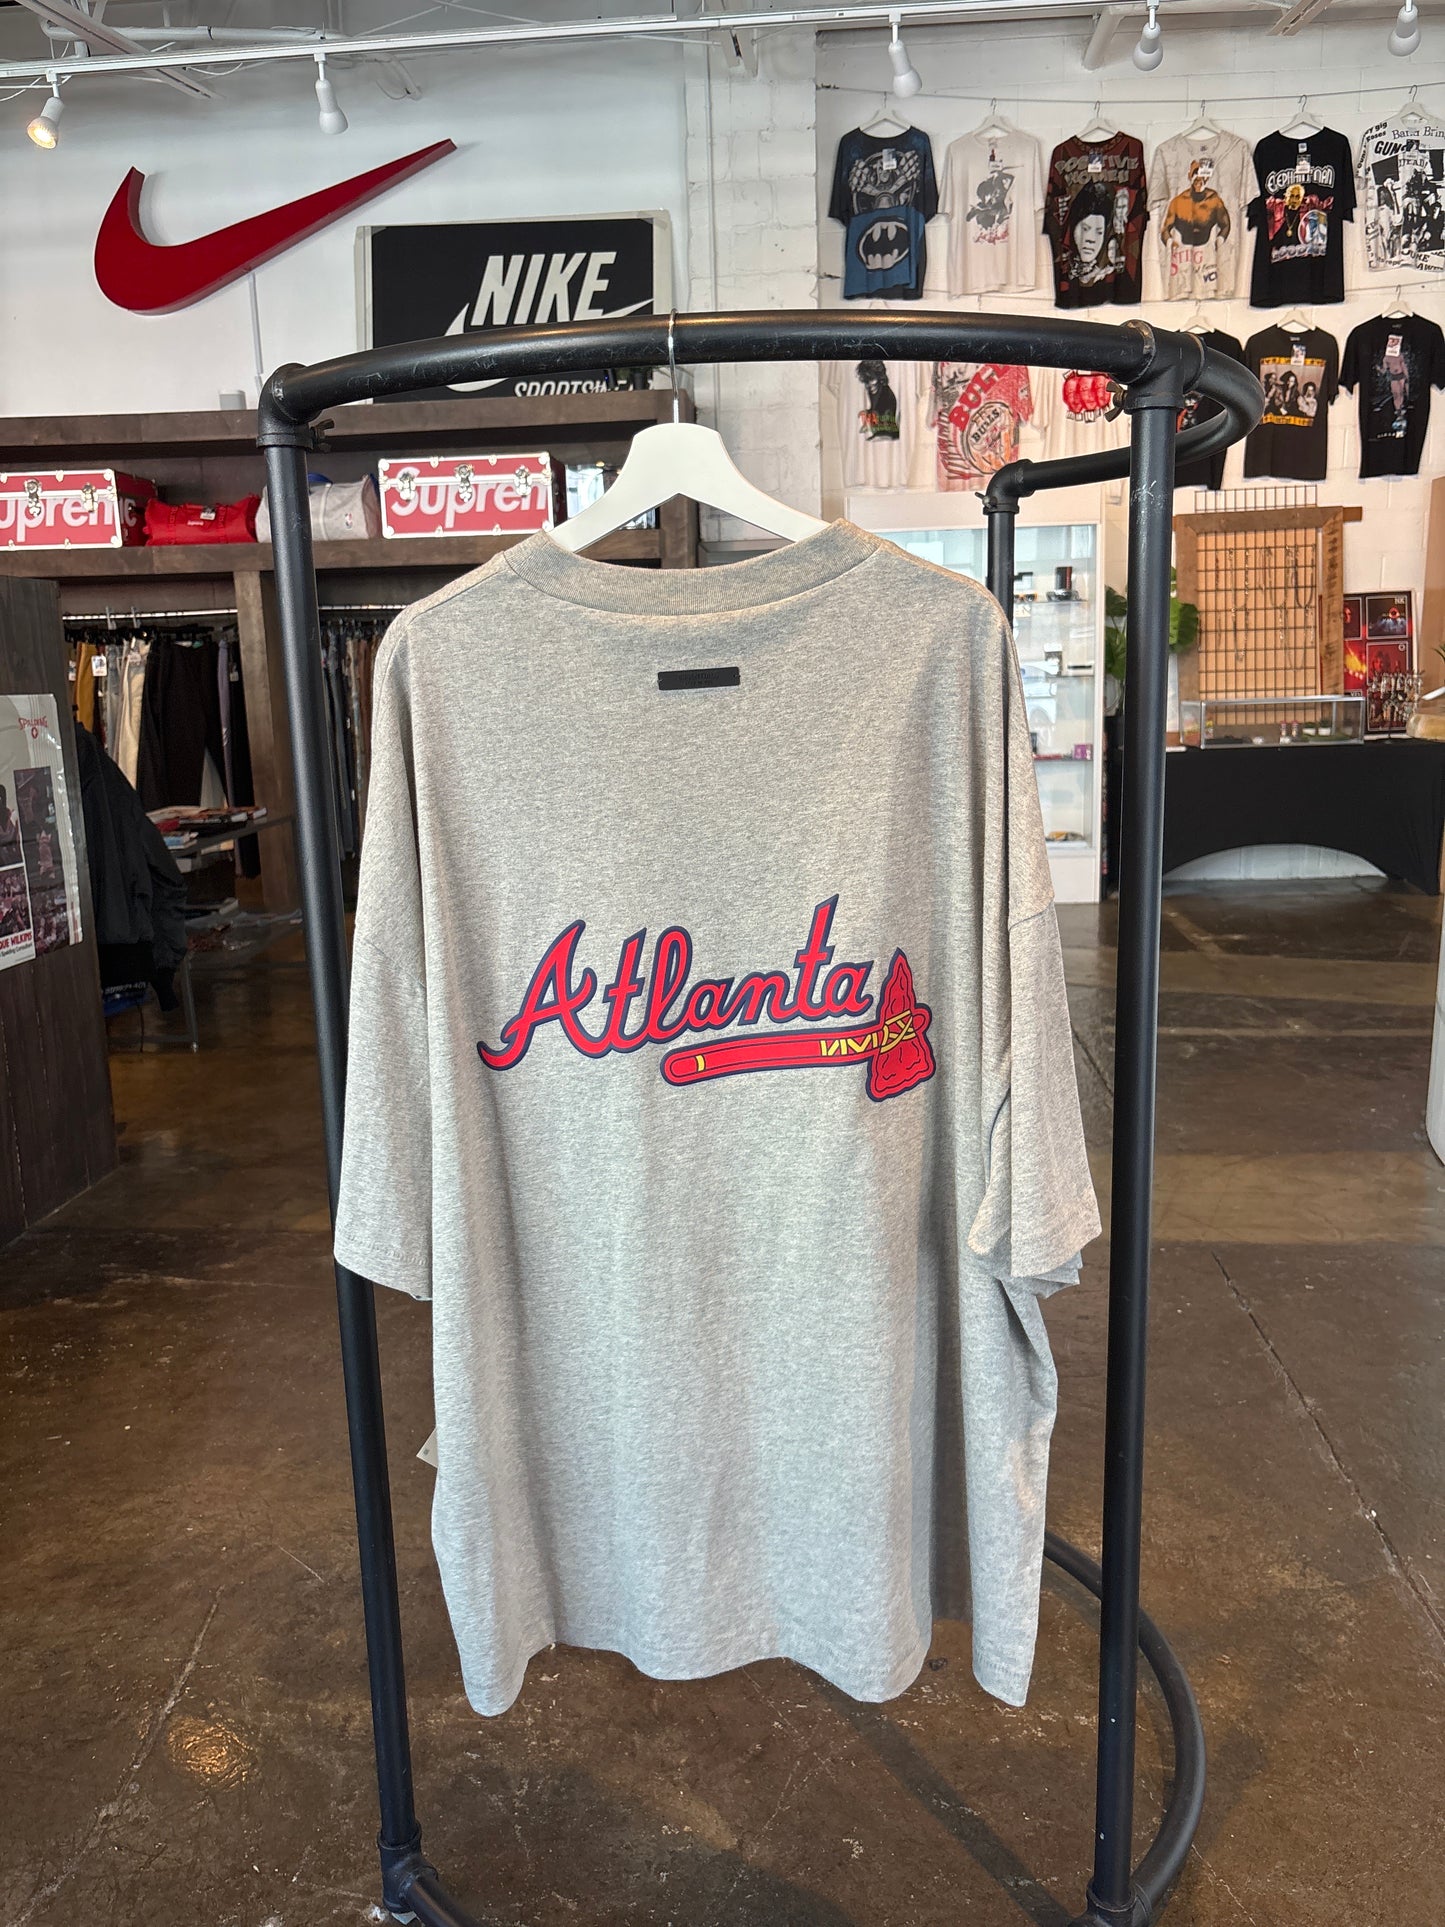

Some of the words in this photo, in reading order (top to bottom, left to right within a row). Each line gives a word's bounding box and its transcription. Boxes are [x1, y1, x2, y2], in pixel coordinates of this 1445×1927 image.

[1423, 126, 1445, 140] Brin
[470, 252, 617, 326] NIKE
[971, 408, 1001, 443] BULLS
[478, 894, 874, 1071] Atlanta
